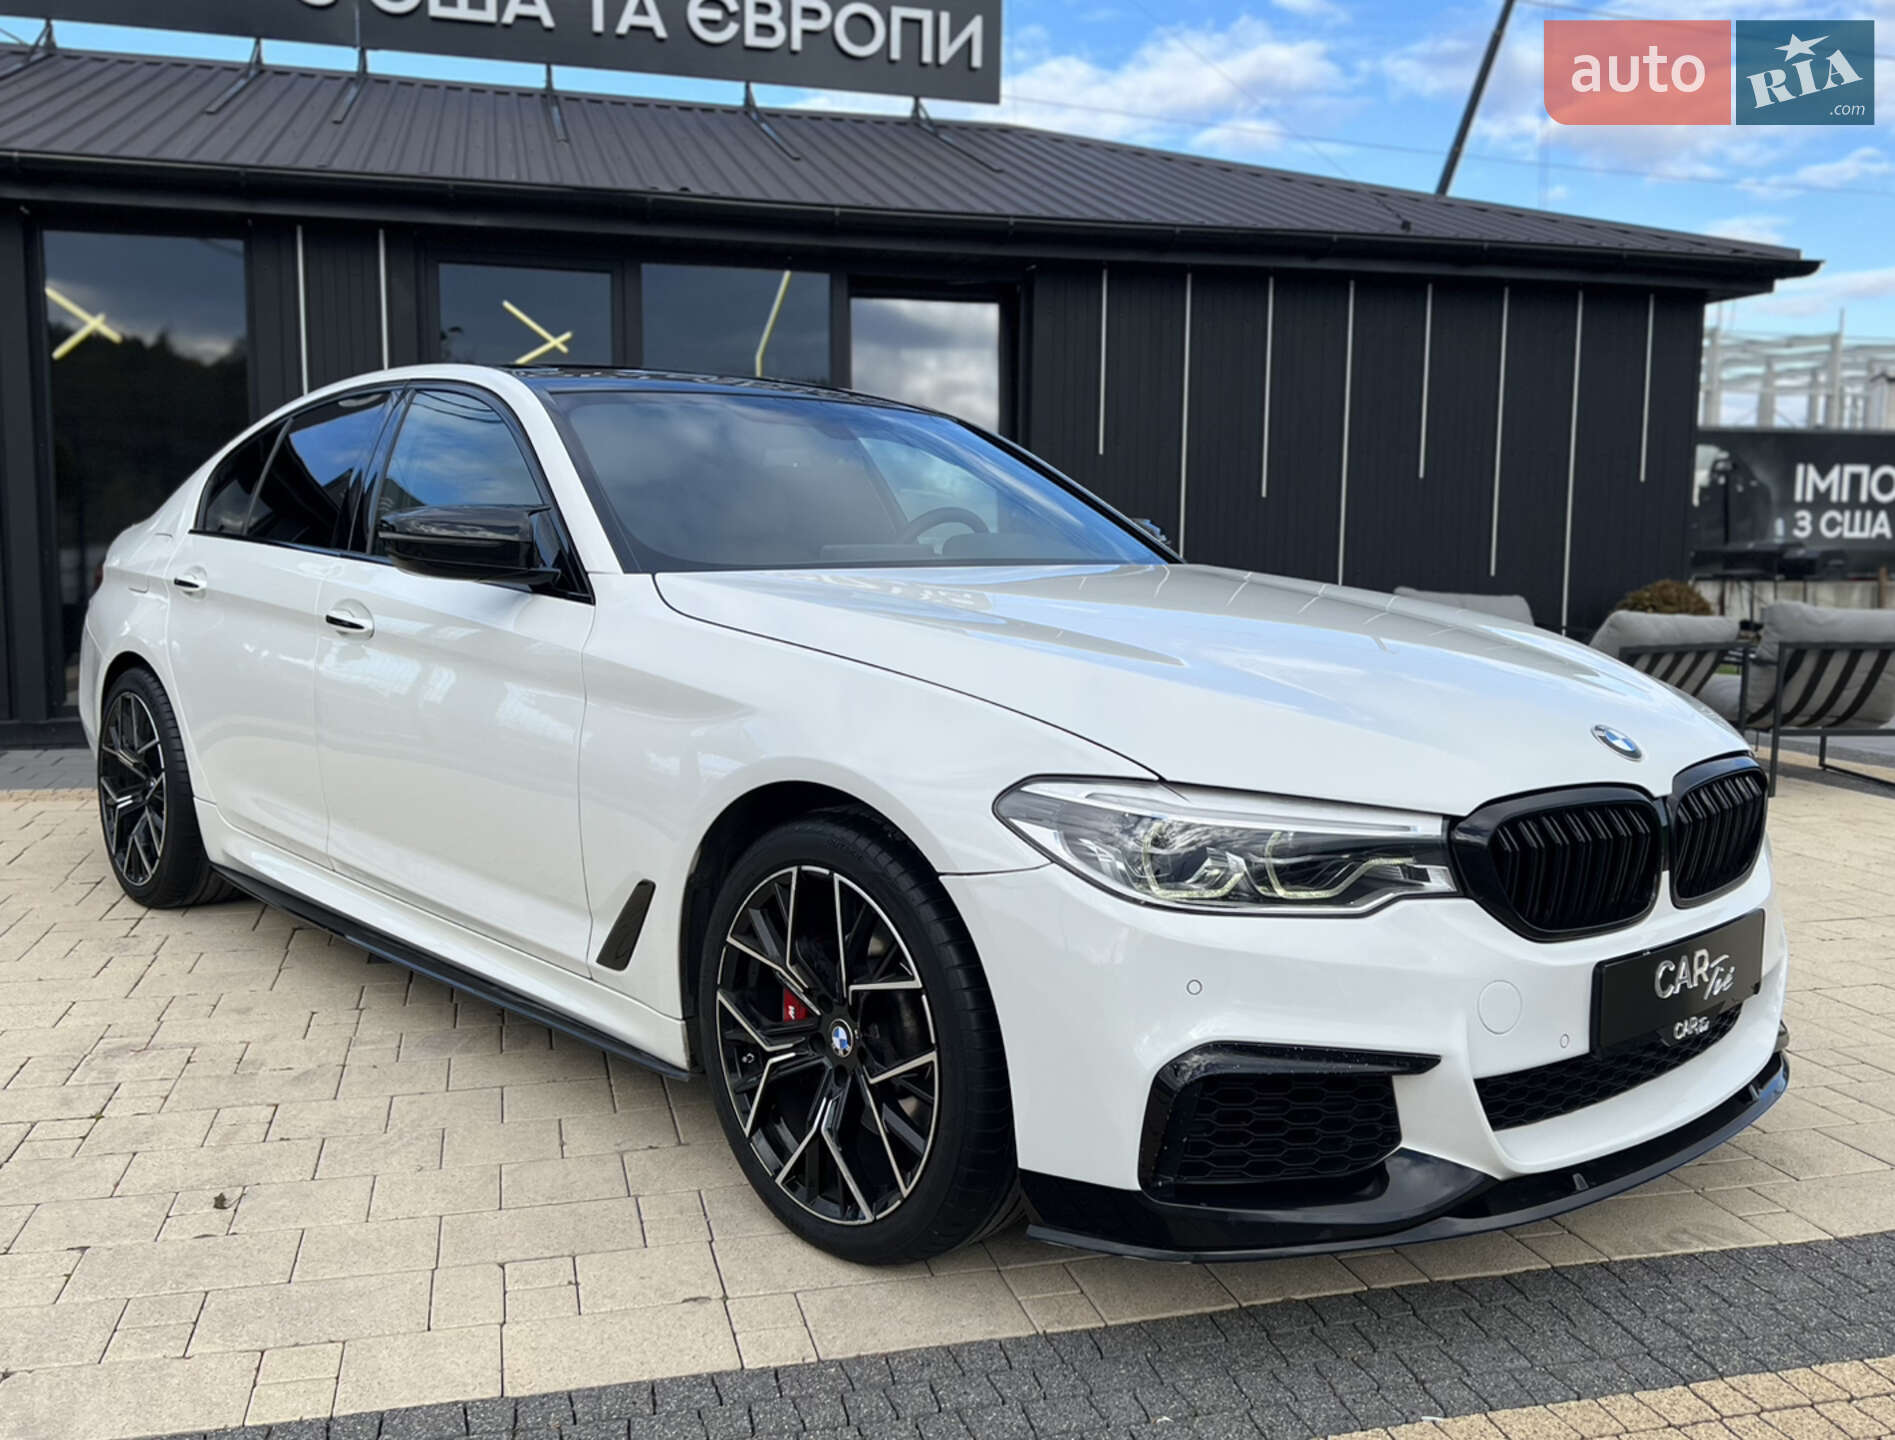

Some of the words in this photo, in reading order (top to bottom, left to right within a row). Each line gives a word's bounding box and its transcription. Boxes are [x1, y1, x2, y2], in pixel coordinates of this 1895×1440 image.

[686, 0, 983, 68] ЄВРОПИ
[1792, 510, 1812, 538] З
[1819, 510, 1892, 539] США
